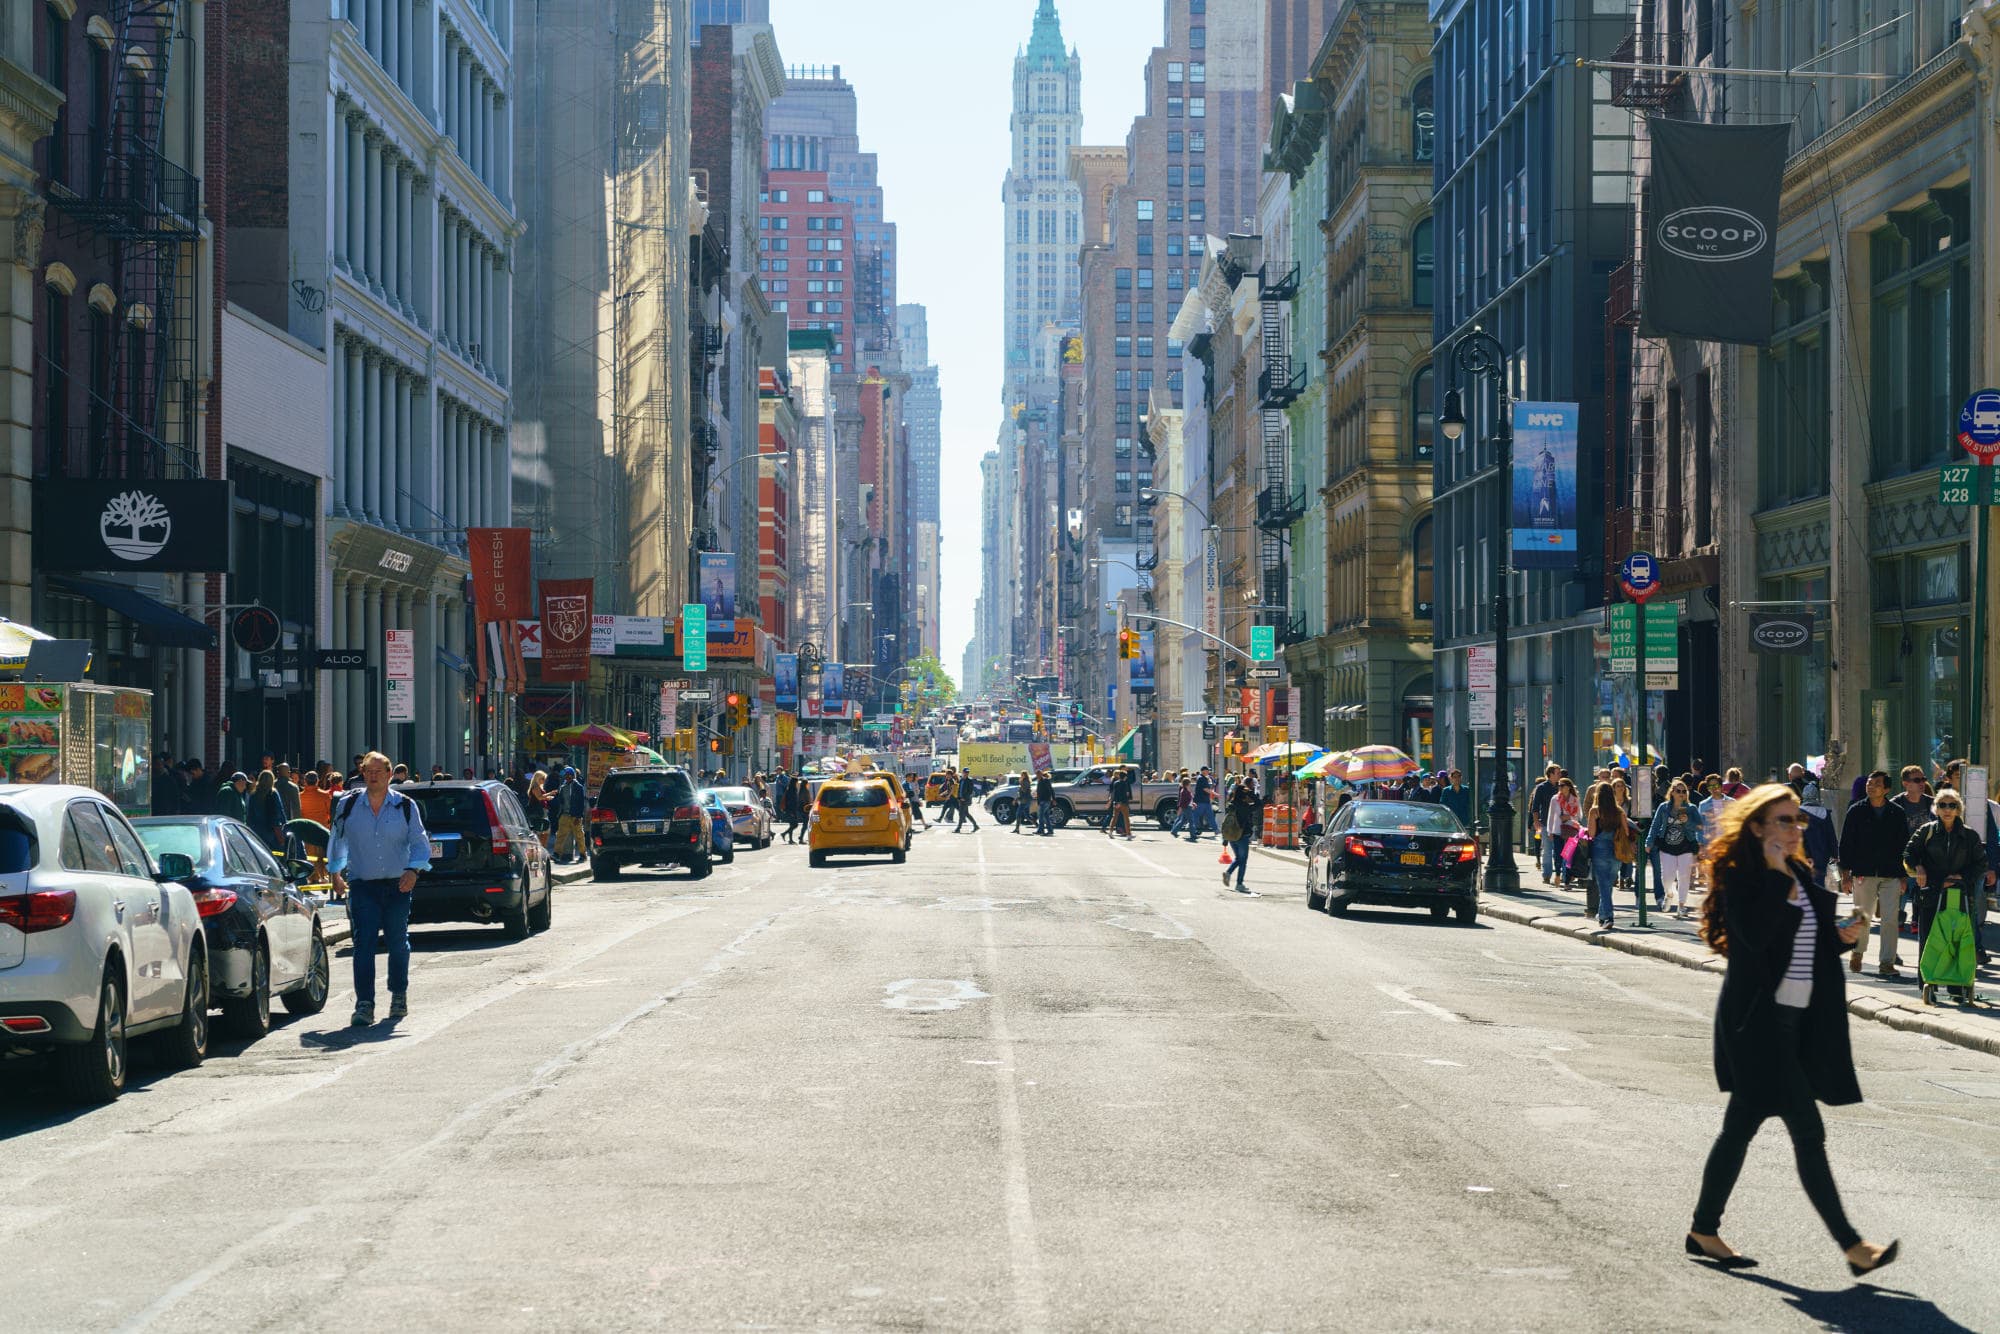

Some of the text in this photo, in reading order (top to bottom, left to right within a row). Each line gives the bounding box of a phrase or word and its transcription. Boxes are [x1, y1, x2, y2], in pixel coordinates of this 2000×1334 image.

[1667, 226, 1756, 242] SCOOP
[1527, 413, 1563, 427] NYC
[1962, 434, 1974, 447] NO
[708, 558, 727, 566] NYC
[492, 531, 506, 610] JOE FRESH
[1631, 582, 1657, 595] STANDING
[557, 600, 576, 610] ICC
[325, 656, 362, 664] ALDO
[0, 701, 18, 709] OD
[967, 754, 988, 766] you'll
[989, 754, 1005, 763] feel
[1006, 754, 1026, 767] good
